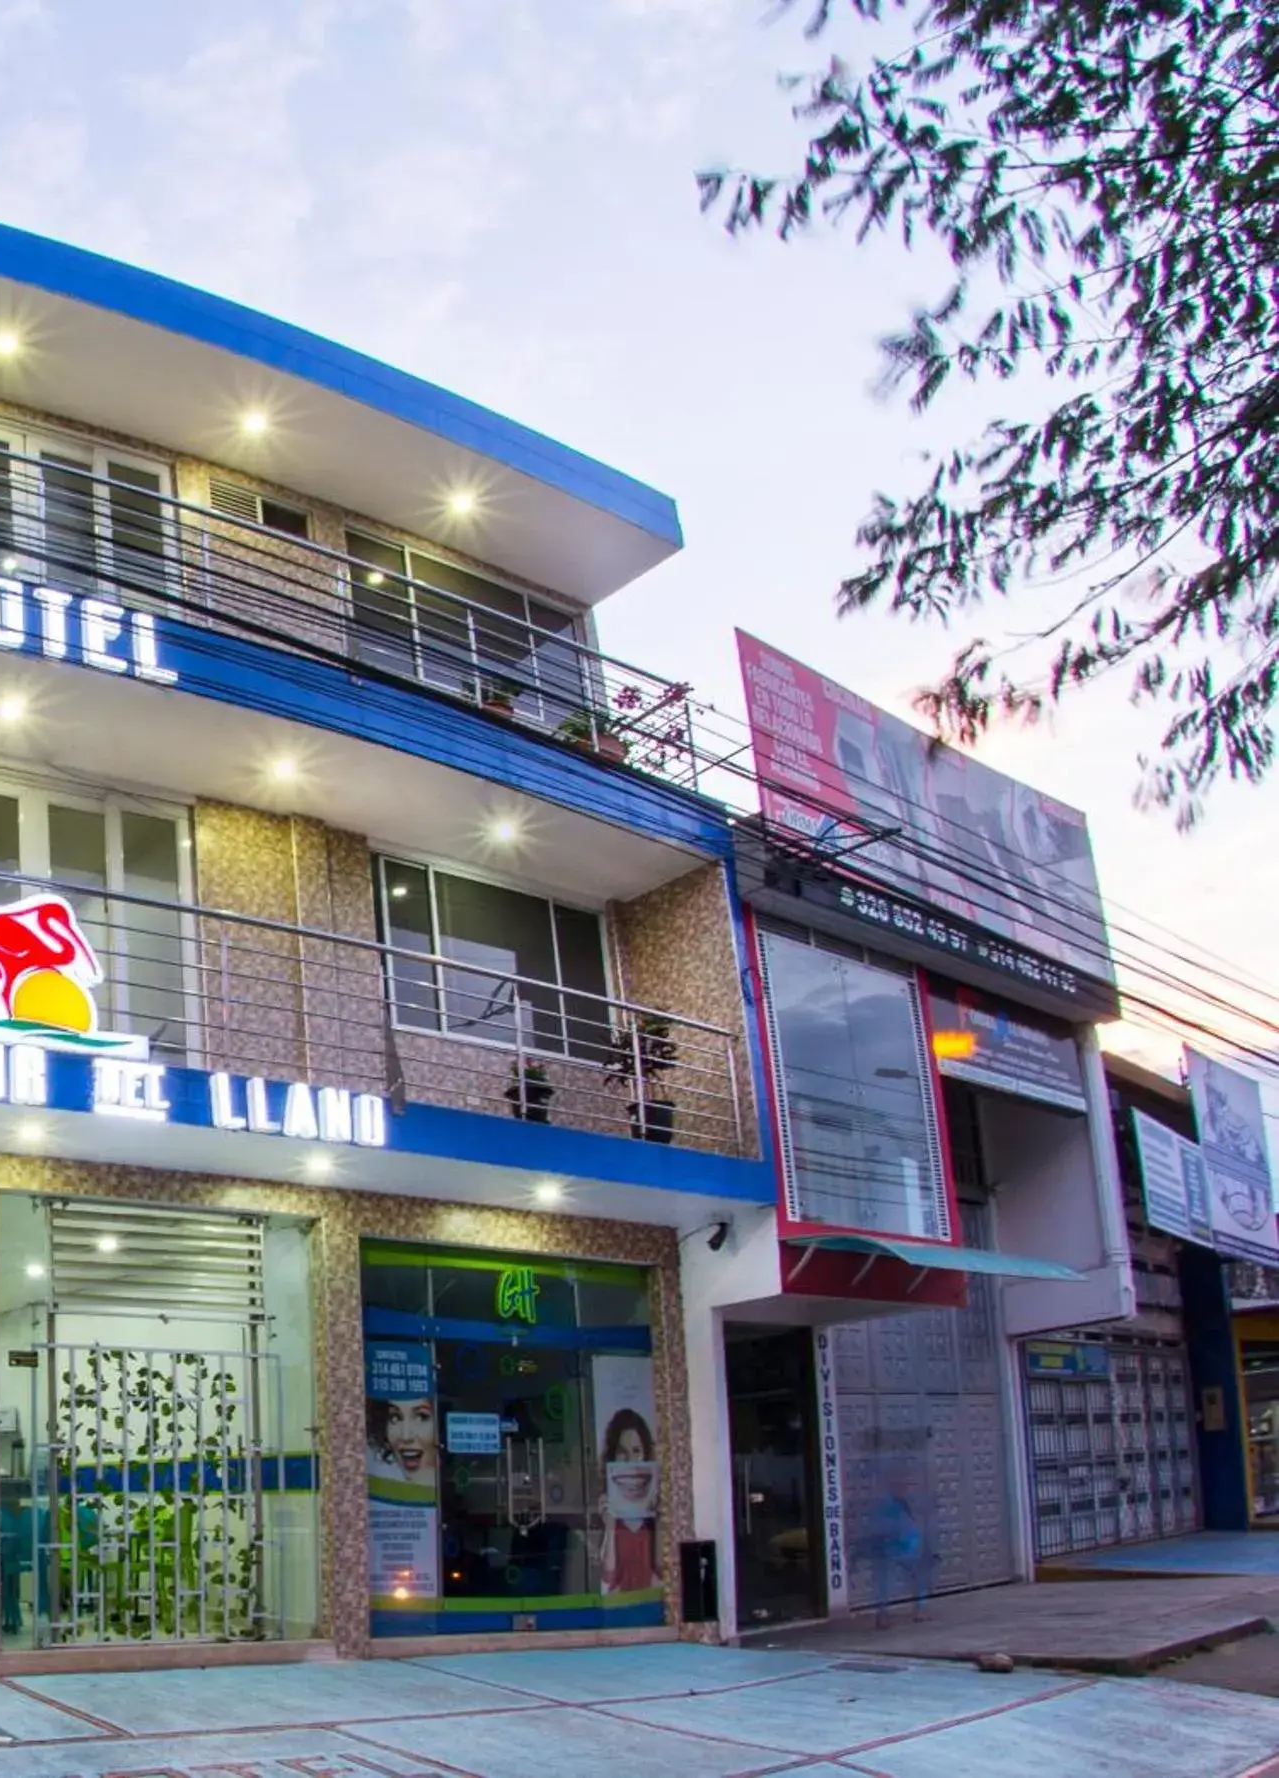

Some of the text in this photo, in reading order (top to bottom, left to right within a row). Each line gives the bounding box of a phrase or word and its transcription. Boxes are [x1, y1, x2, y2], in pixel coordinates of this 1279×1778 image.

[92, 1057, 171, 1111] DEL
[209, 1071, 386, 1147] LLANO
[818, 1333, 839, 1502] DIVISIONES
